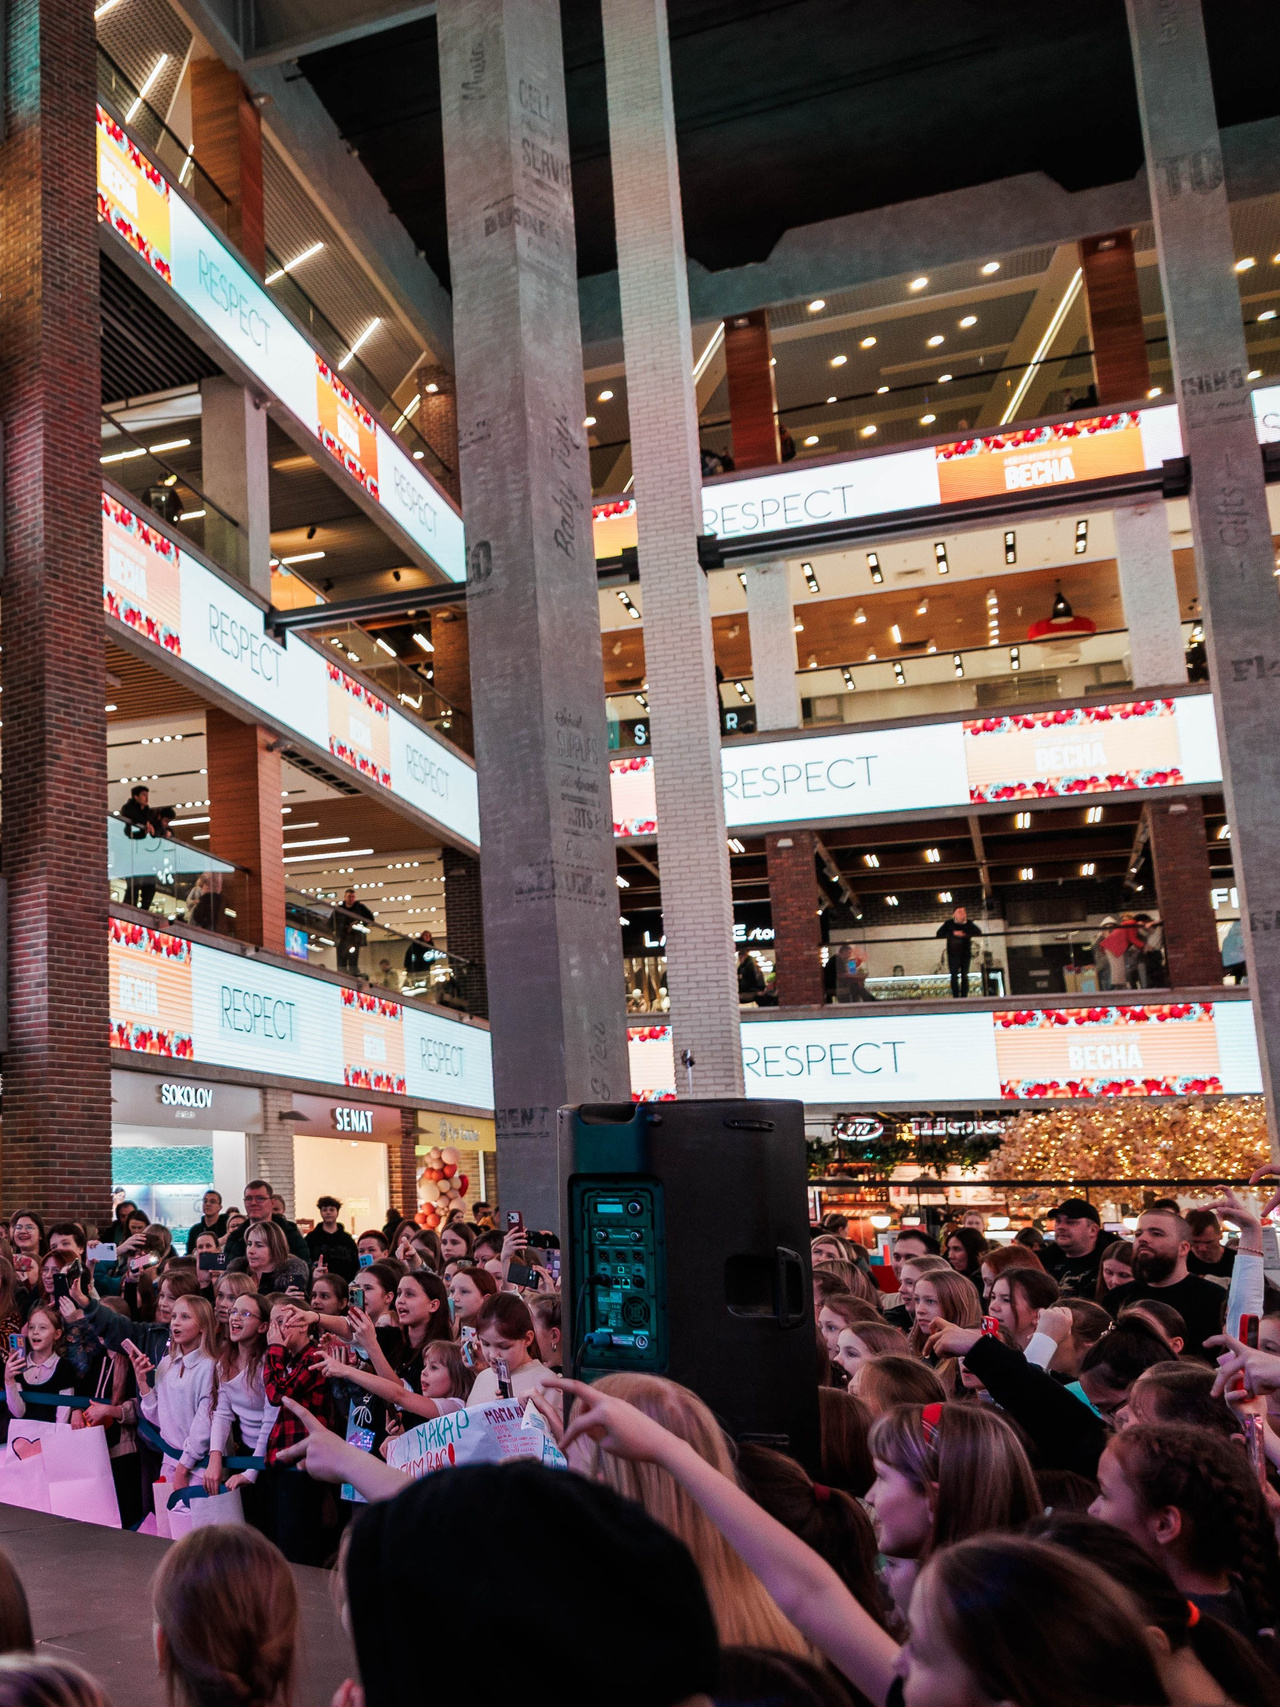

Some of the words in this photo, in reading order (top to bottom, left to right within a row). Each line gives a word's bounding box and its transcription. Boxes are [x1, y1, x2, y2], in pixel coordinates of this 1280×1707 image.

[198, 249, 271, 356] RESPECT
[1004, 456, 1075, 490] ВЕСНА
[393, 465, 438, 538] RESPECT
[208, 603, 282, 688] RESPECT
[405, 744, 450, 801] RESPECT
[721, 755, 879, 800] RESPECT
[220, 984, 296, 1042] RESPECT
[420, 1036, 464, 1078] RESPECT
[742, 1041, 906, 1077] RESPECT
[1067, 1044, 1143, 1071] ВЕСНА
[160, 1083, 213, 1109] SOKOLOV
[334, 1107, 374, 1134] SENAT
[416, 1409, 470, 1457] МАКАР
[483, 1406, 516, 1426] МАМА
